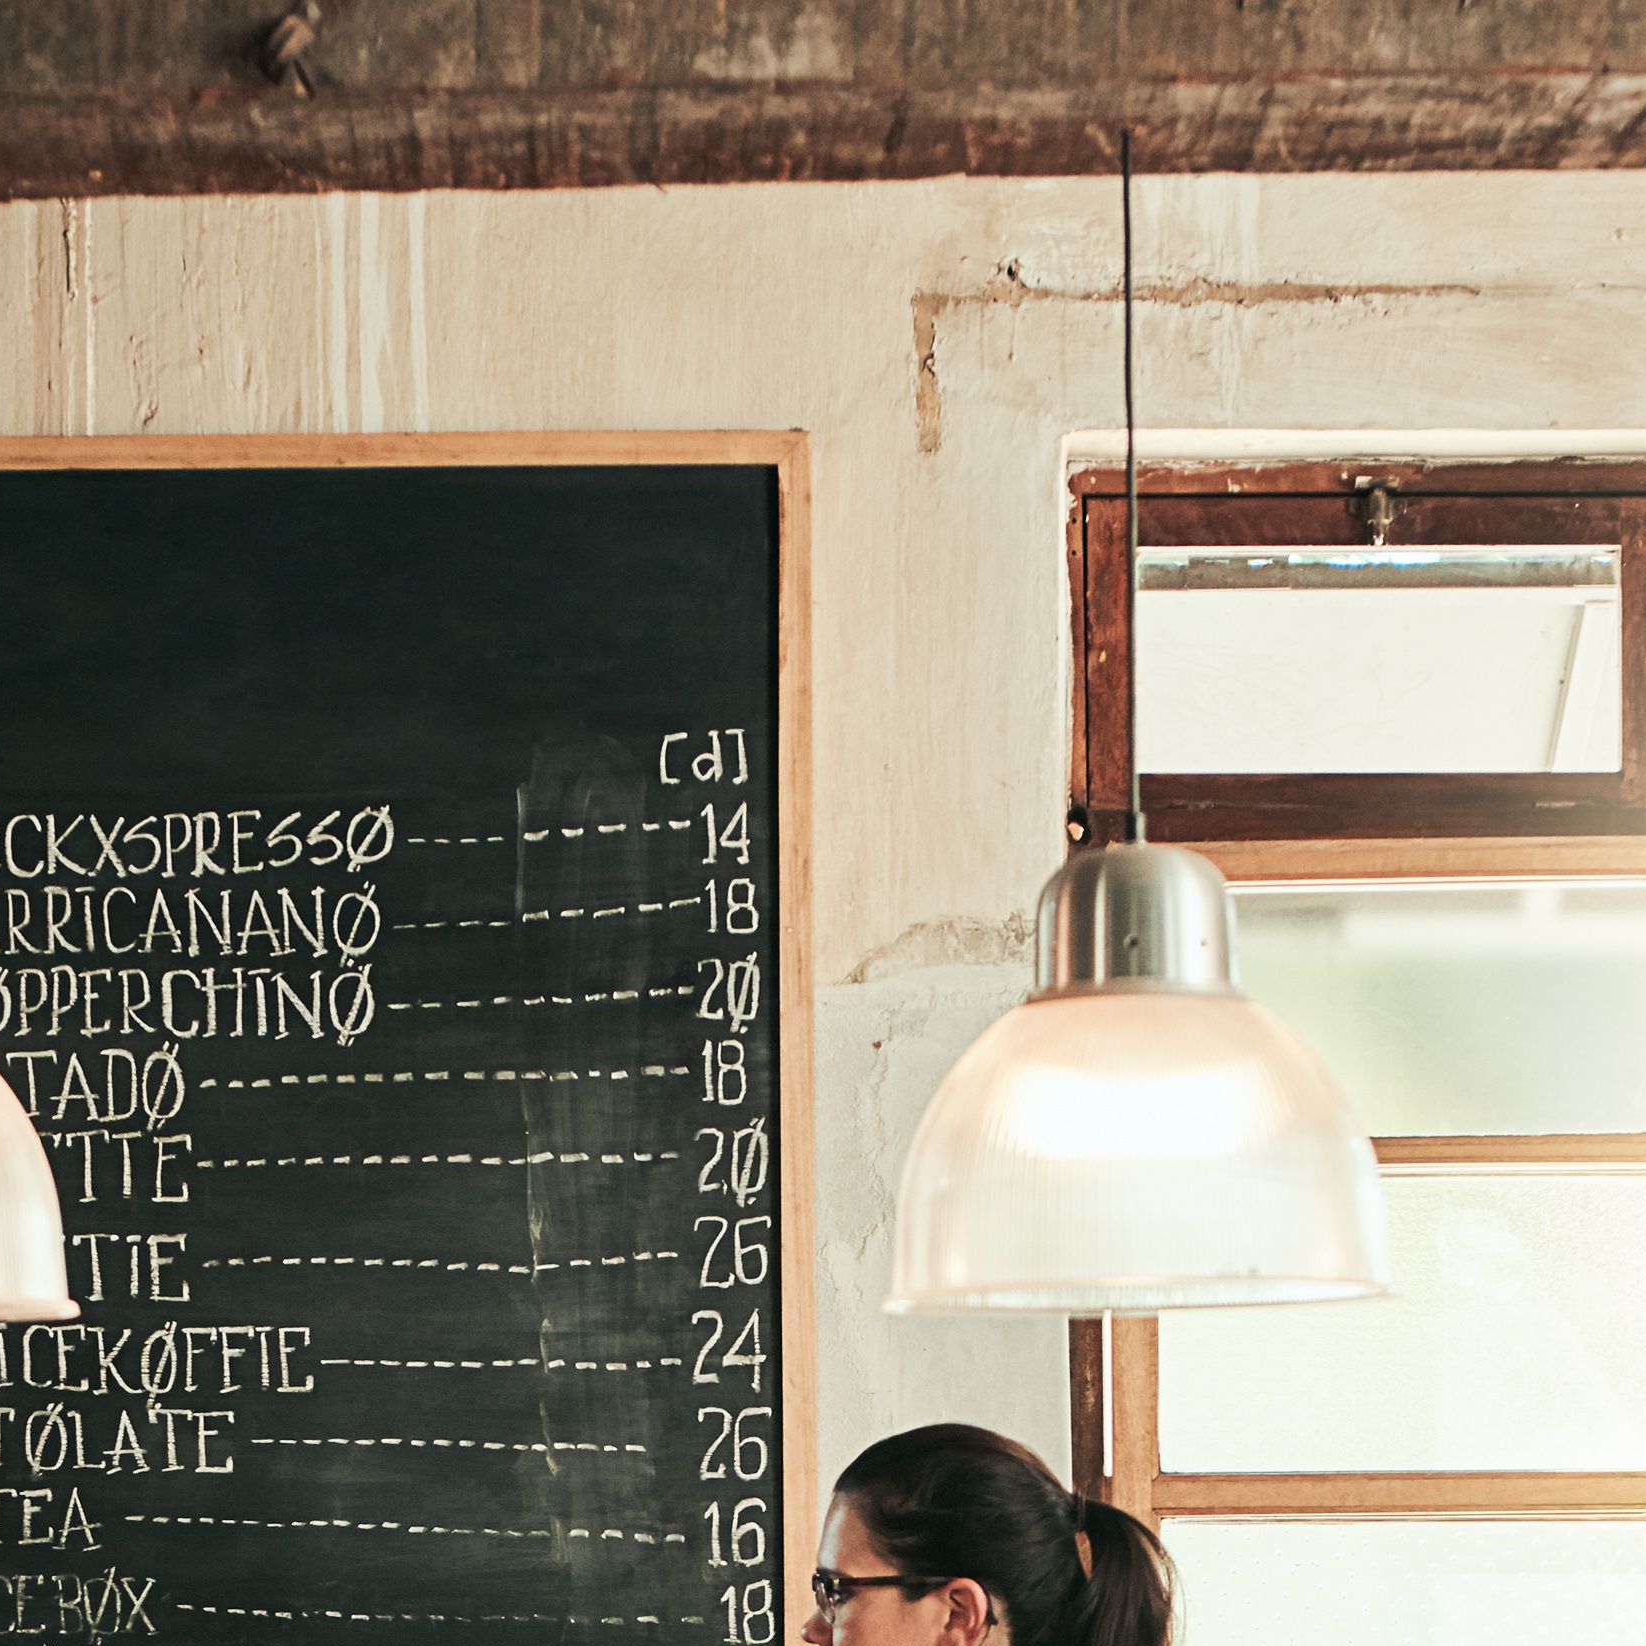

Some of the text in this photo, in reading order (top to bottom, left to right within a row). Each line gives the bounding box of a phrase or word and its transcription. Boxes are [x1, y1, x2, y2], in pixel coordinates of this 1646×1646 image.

[700, 801, 751, 865] 14
[705, 877, 760, 935] 18
[701, 1038, 747, 1106] 18
[693, 1215, 772, 1289] 26
[691, 1307, 767, 1393] 24
[697, 1406, 773, 1481] 26
[704, 1497, 767, 1568] 16
[719, 1578, 776, 1645] 18
